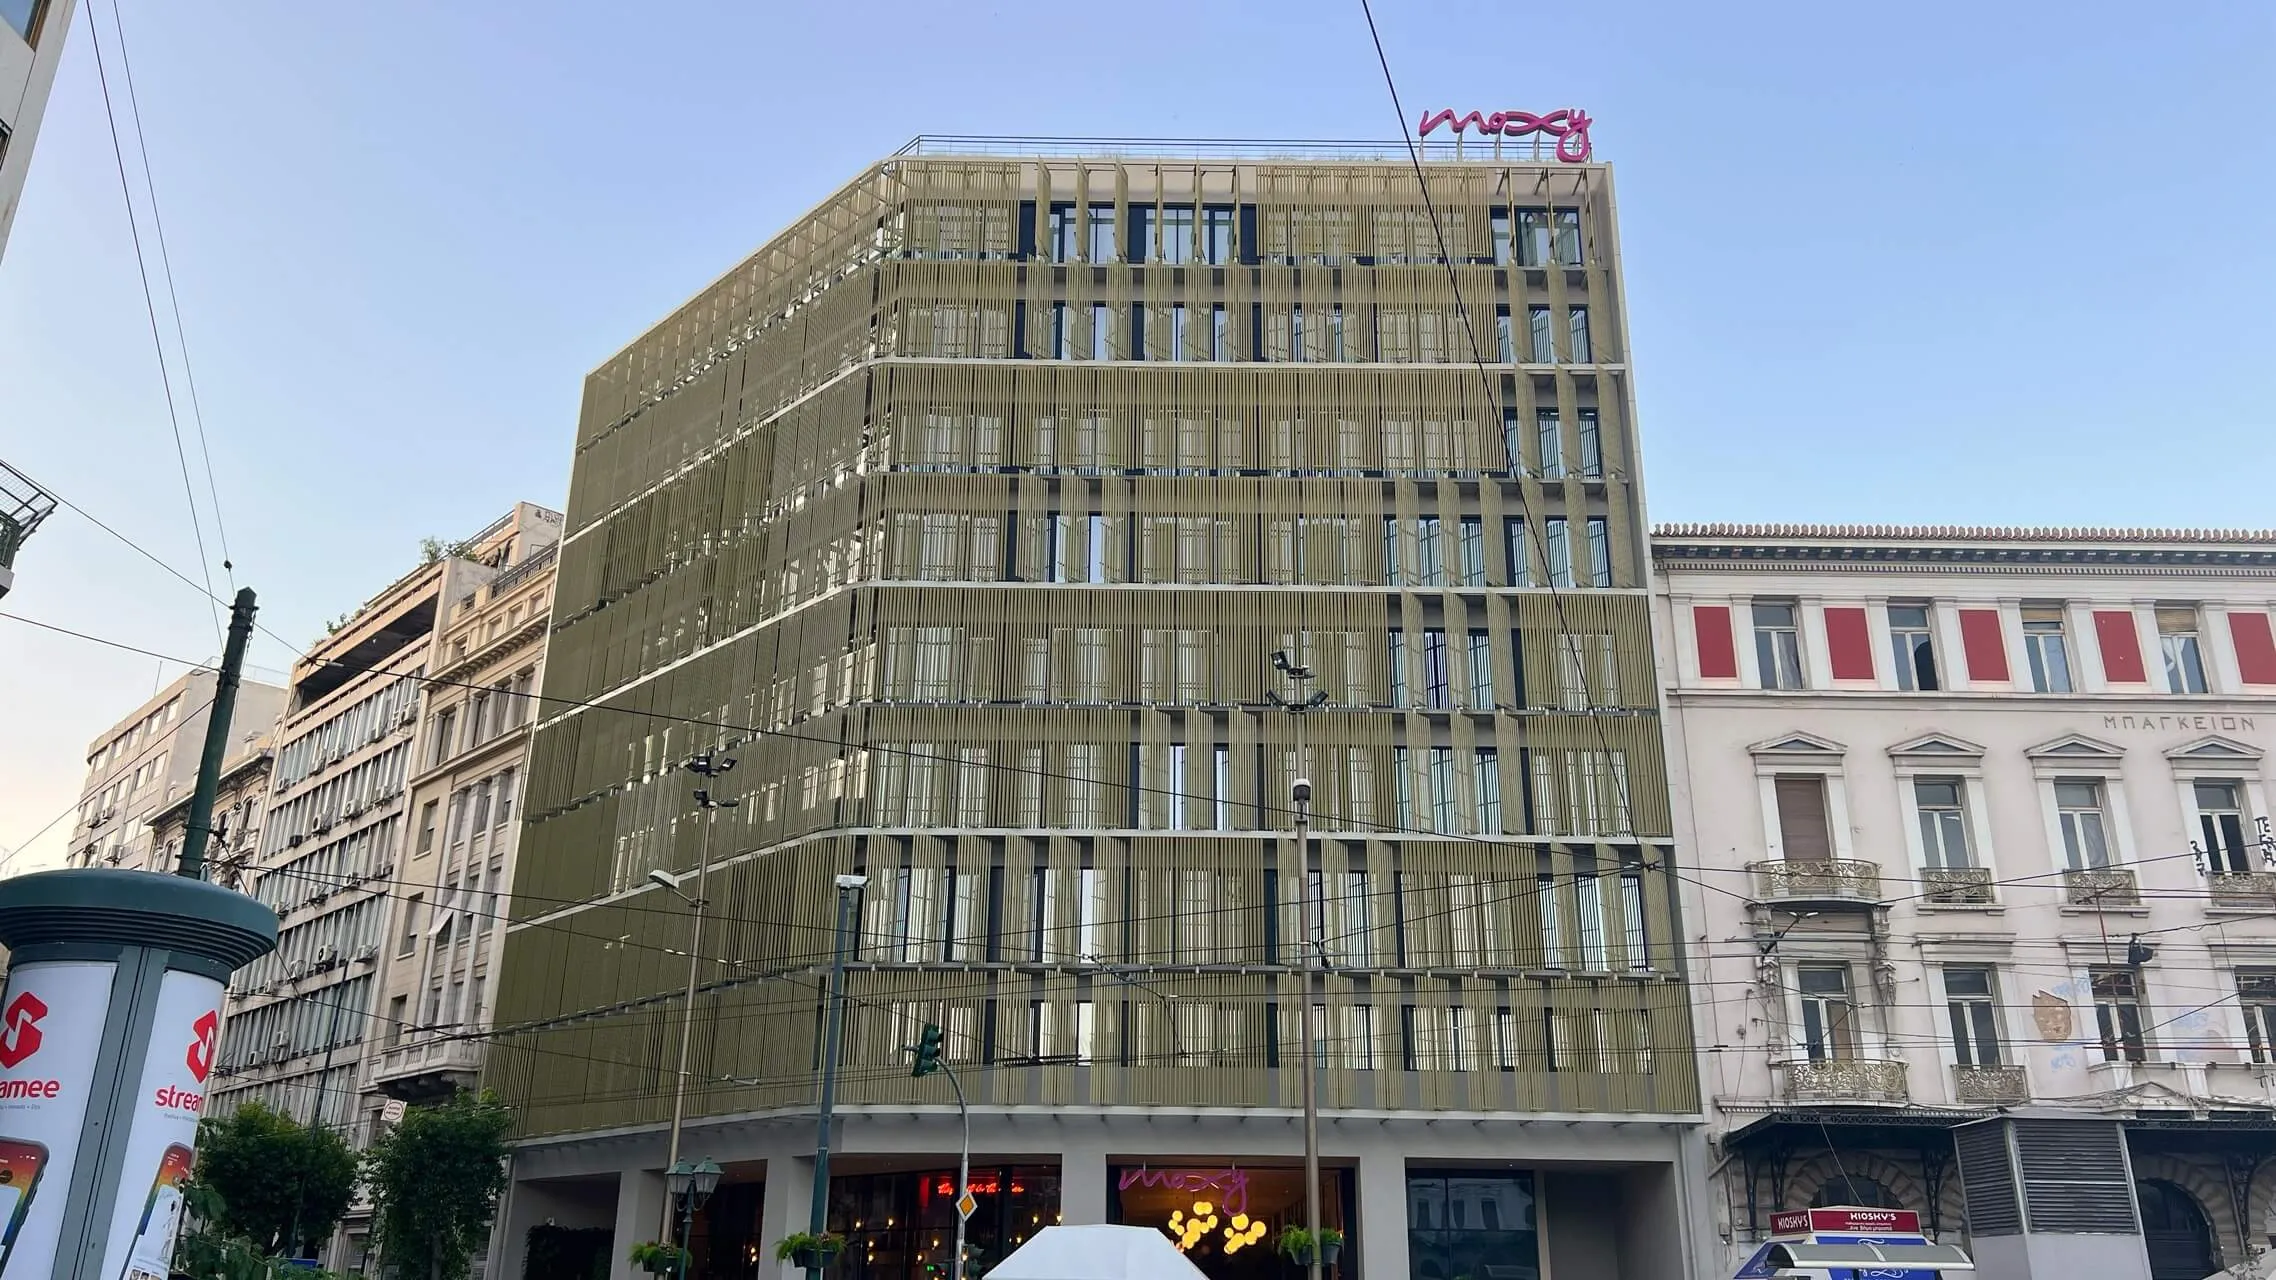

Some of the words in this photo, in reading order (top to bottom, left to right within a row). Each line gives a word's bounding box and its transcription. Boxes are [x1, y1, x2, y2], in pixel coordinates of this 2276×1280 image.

[2103, 715, 2256, 731] ΜΠΑΓΚΕΙΟΝ
[0, 1080, 60, 1099] amee
[1850, 1211, 1897, 1221] KIOSKY'S
